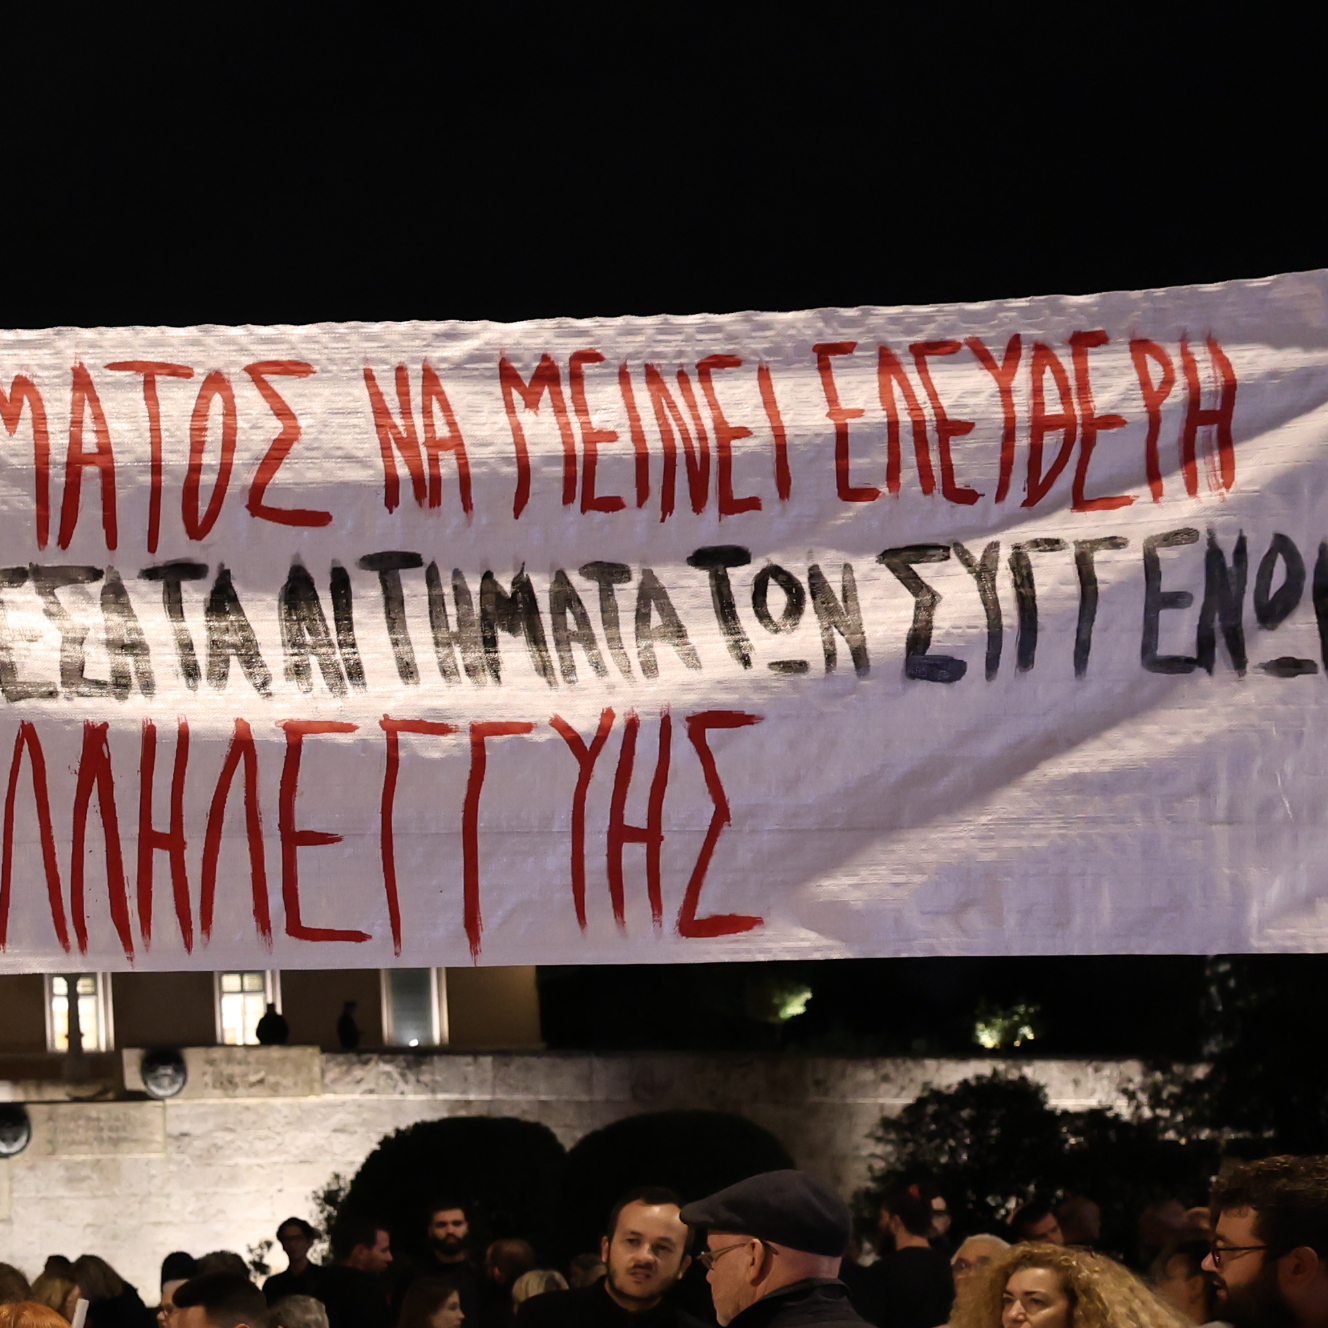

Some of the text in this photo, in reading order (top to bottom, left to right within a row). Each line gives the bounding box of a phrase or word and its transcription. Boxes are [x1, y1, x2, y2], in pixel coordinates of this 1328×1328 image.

[363, 358, 472, 520] ΝΑ
[498, 348, 792, 523] ΜΕΙΝΕΙ
[812, 329, 1238, 512] ΕΛΕΥΘΕΡΗ
[138, 558, 274, 700] ΤΑ
[278, 550, 702, 698] ΑΙΤΗΜΑΤΑ
